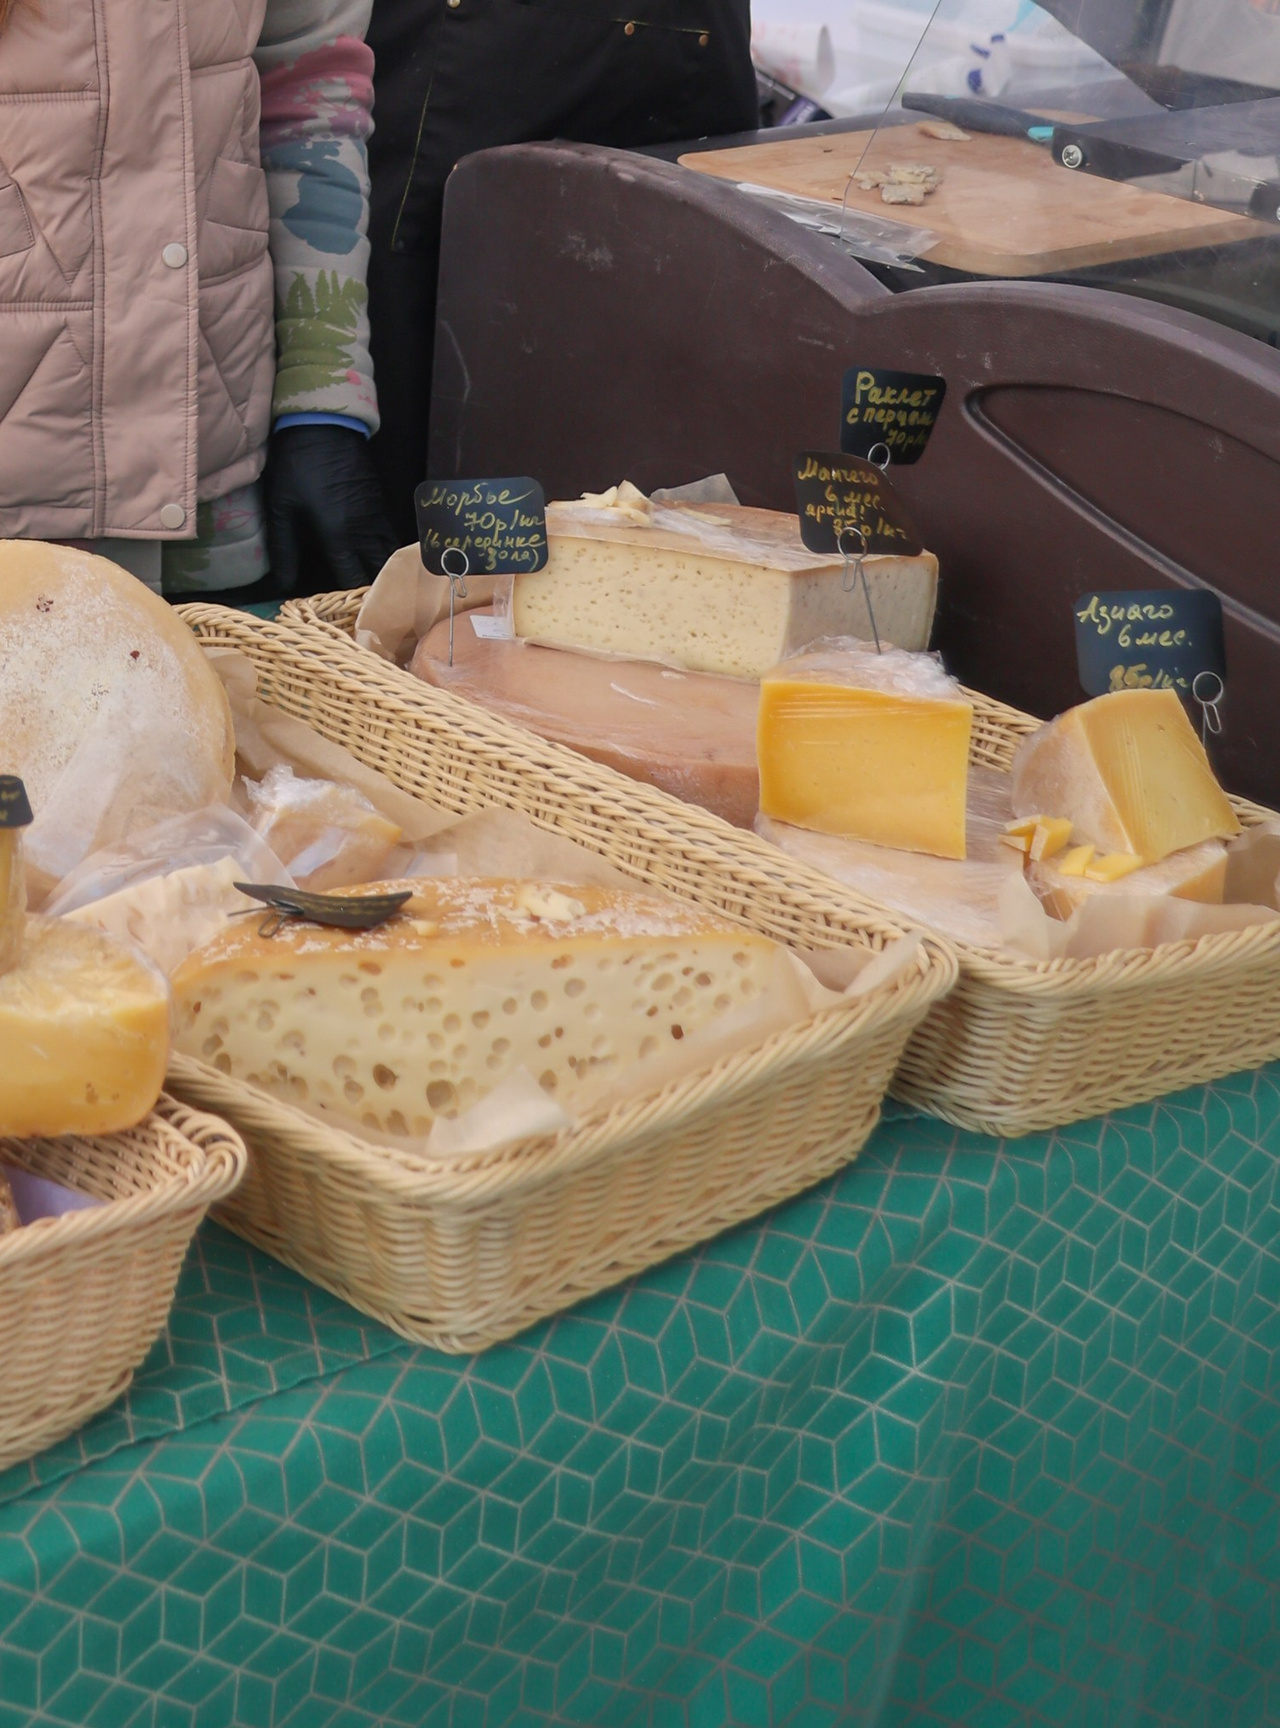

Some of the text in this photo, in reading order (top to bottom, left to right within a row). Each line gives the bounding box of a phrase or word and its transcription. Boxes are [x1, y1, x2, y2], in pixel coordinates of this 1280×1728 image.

[855, 371, 937, 407] Раклет
[846, 407, 859, 424] с
[798, 457, 879, 486] Манчего
[421, 482, 536, 516] Морбье
[464, 509, 545, 540] 70р/кг
[1077, 595, 1173, 634] Азиаго
[1118, 624, 1131, 647] 6
